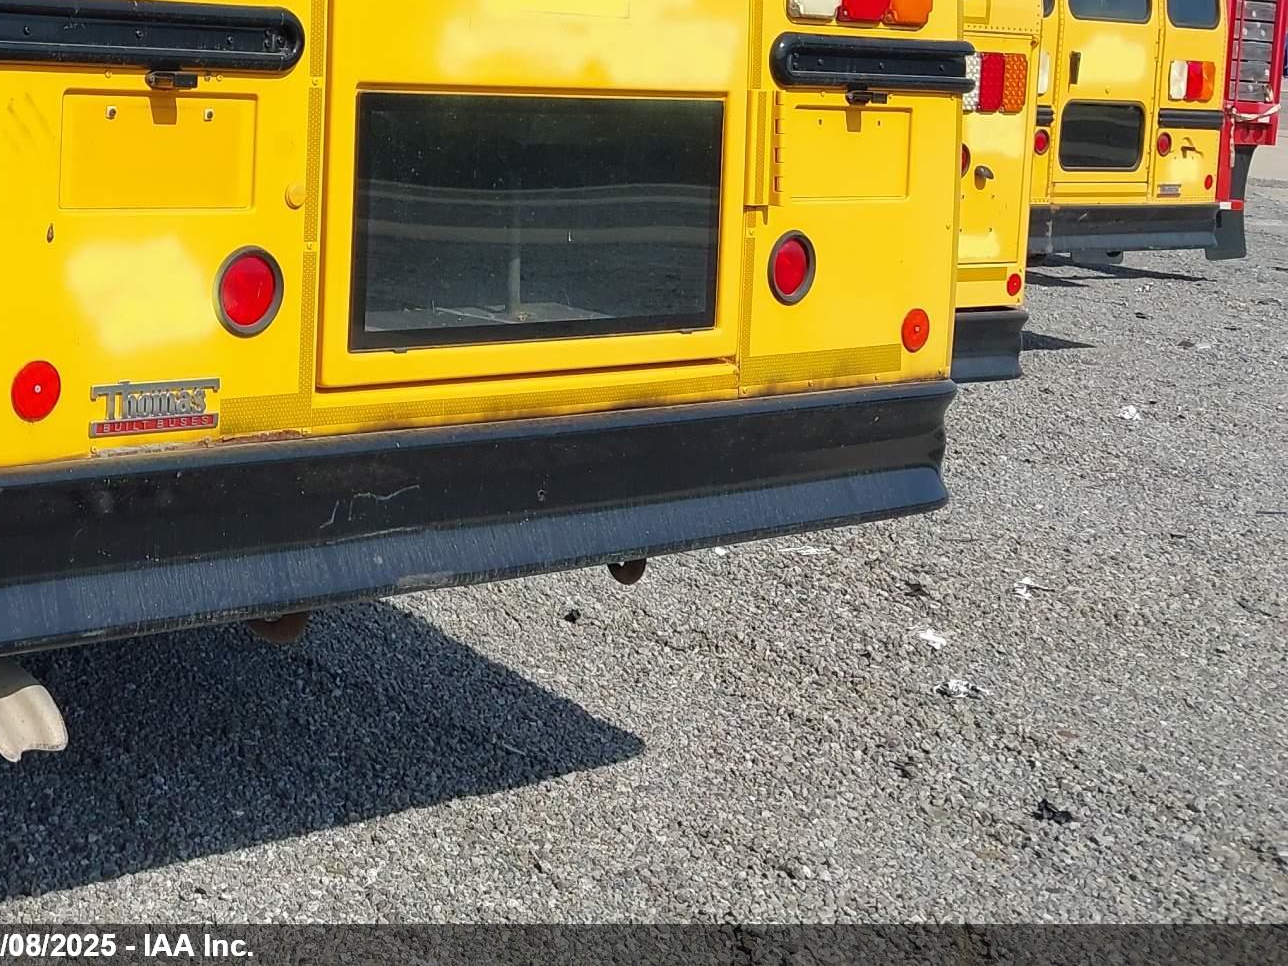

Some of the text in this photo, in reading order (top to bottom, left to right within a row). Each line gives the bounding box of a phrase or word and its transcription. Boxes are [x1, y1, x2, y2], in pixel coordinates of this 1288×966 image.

[90, 377, 220, 422] Thomas
[103, 415, 210, 434] BUILT BUSES
